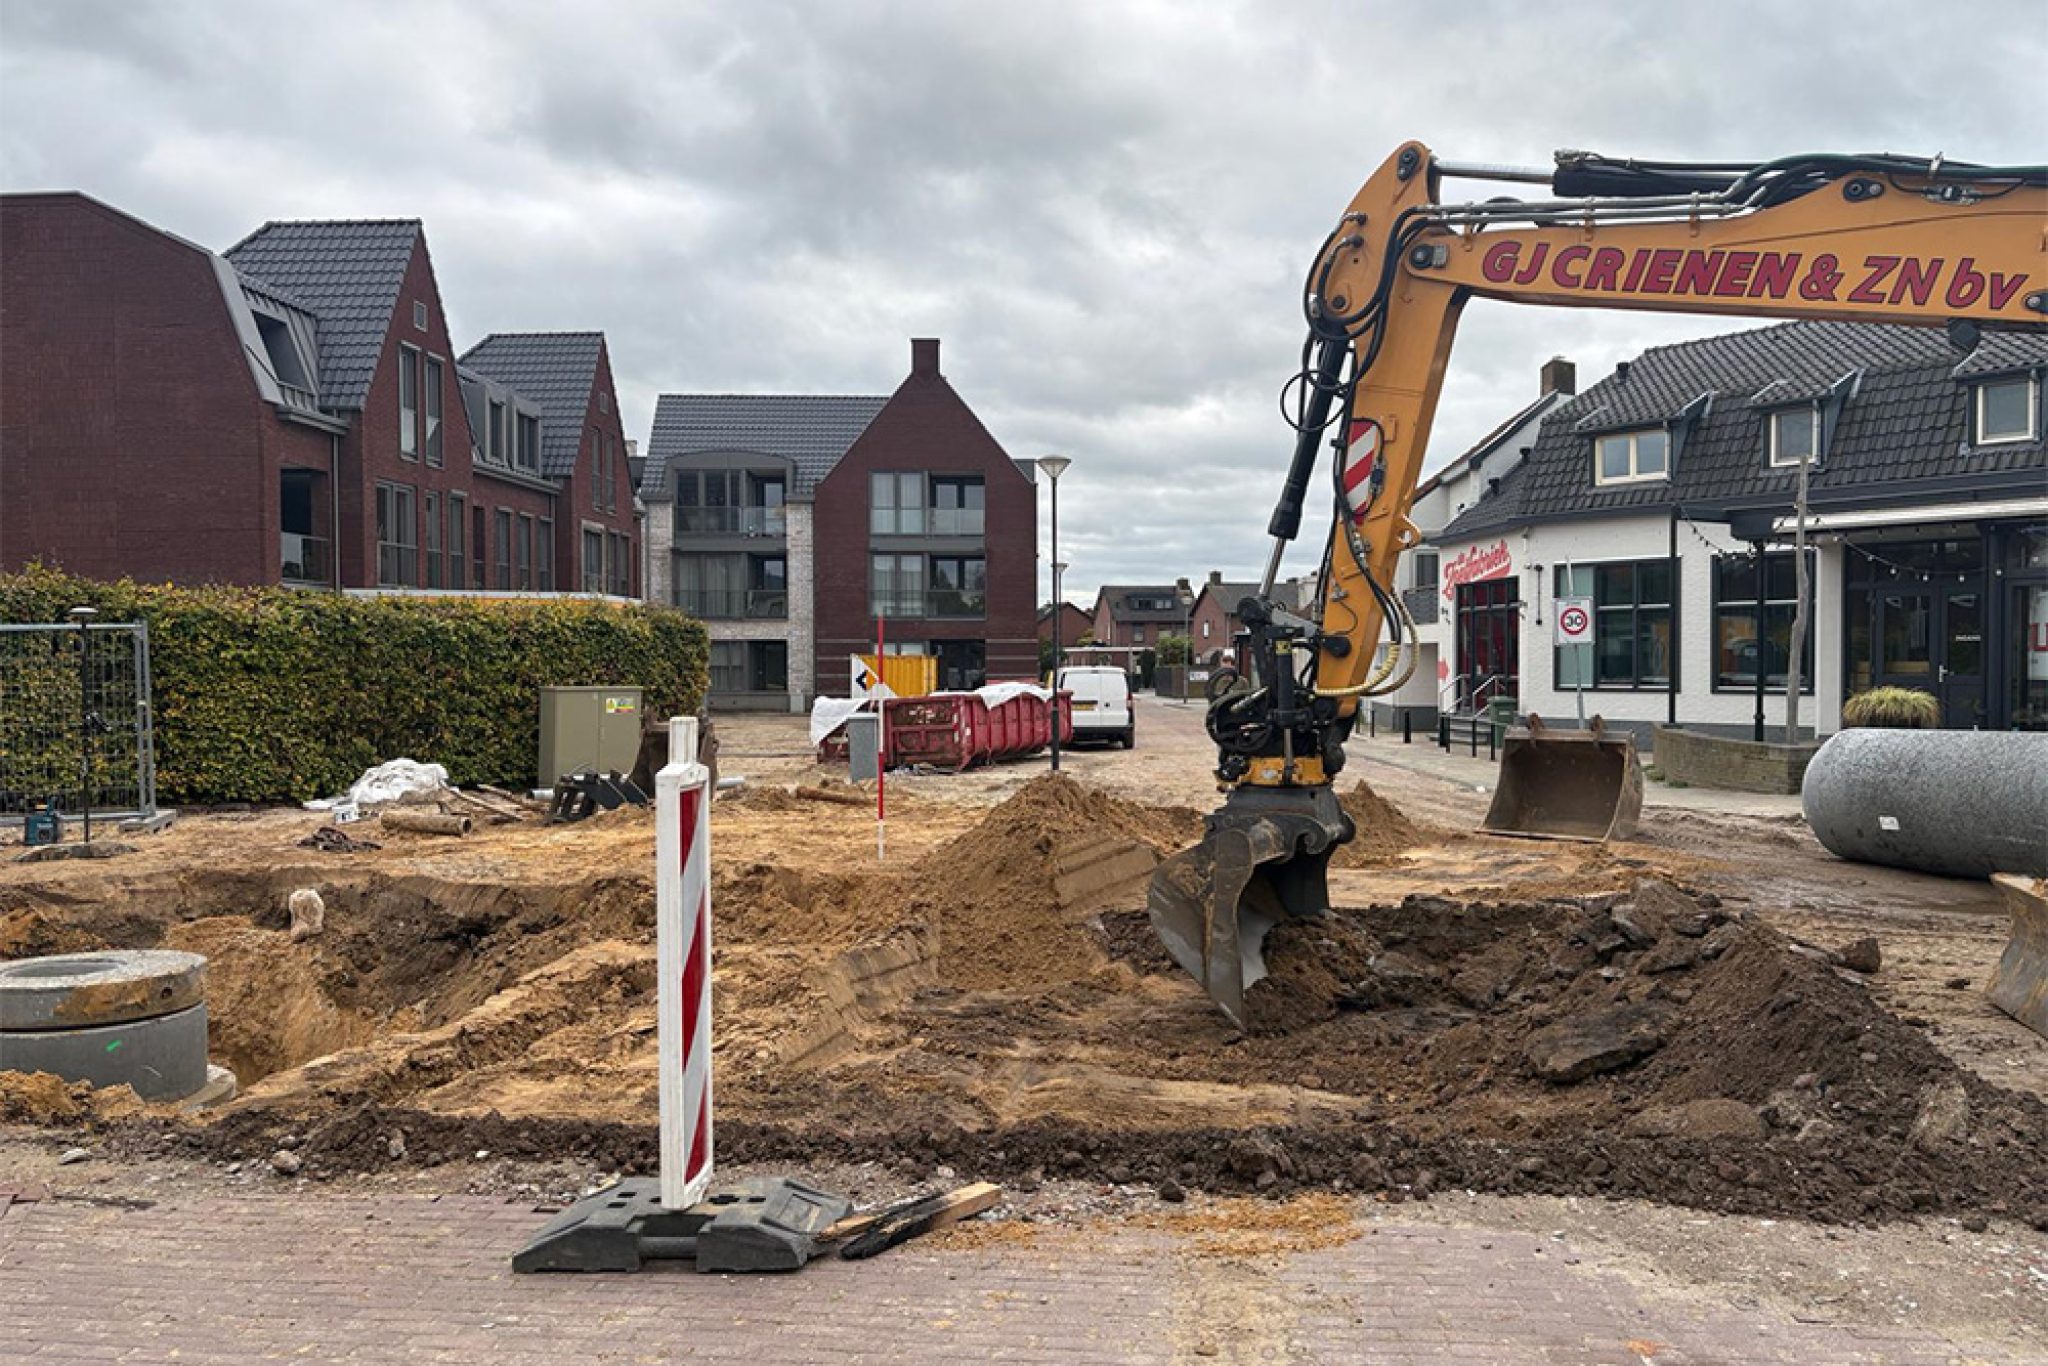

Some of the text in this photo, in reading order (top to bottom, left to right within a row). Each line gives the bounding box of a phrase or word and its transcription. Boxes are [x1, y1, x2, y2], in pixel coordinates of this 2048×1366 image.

[1551, 246, 1802, 299] CRIENEN
[1799, 253, 1845, 302] &
[1847, 255, 1945, 306] ZN
[1945, 257, 2027, 310] bv
[1566, 613, 1584, 628] 30
